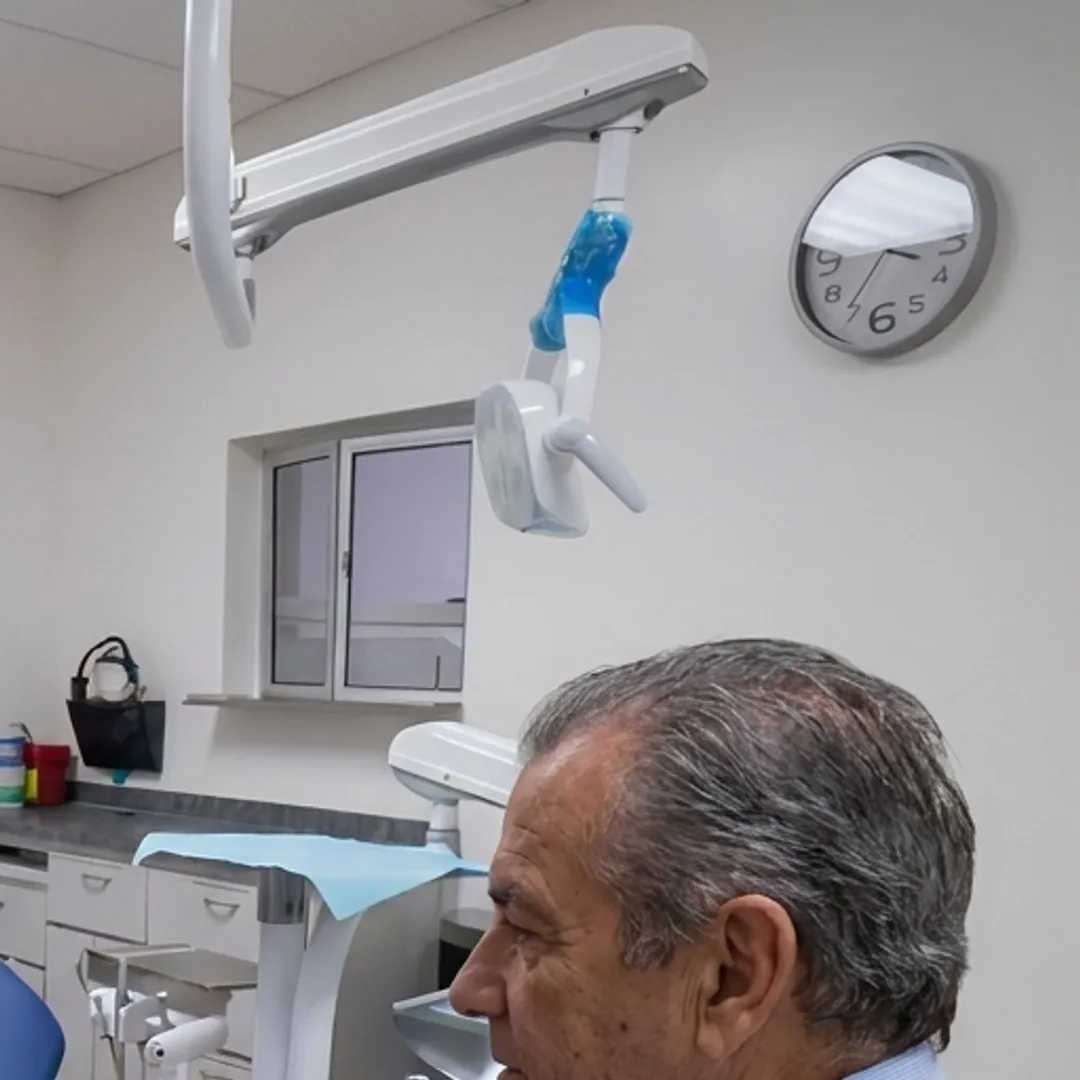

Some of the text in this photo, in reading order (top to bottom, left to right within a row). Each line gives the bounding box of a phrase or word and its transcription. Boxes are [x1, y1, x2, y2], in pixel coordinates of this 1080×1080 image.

[816, 248, 843, 278] 9
[931, 265, 949, 284] 4
[824, 284, 842, 304] 8
[908, 294, 926, 314] 5
[868, 301, 896, 335] 6
